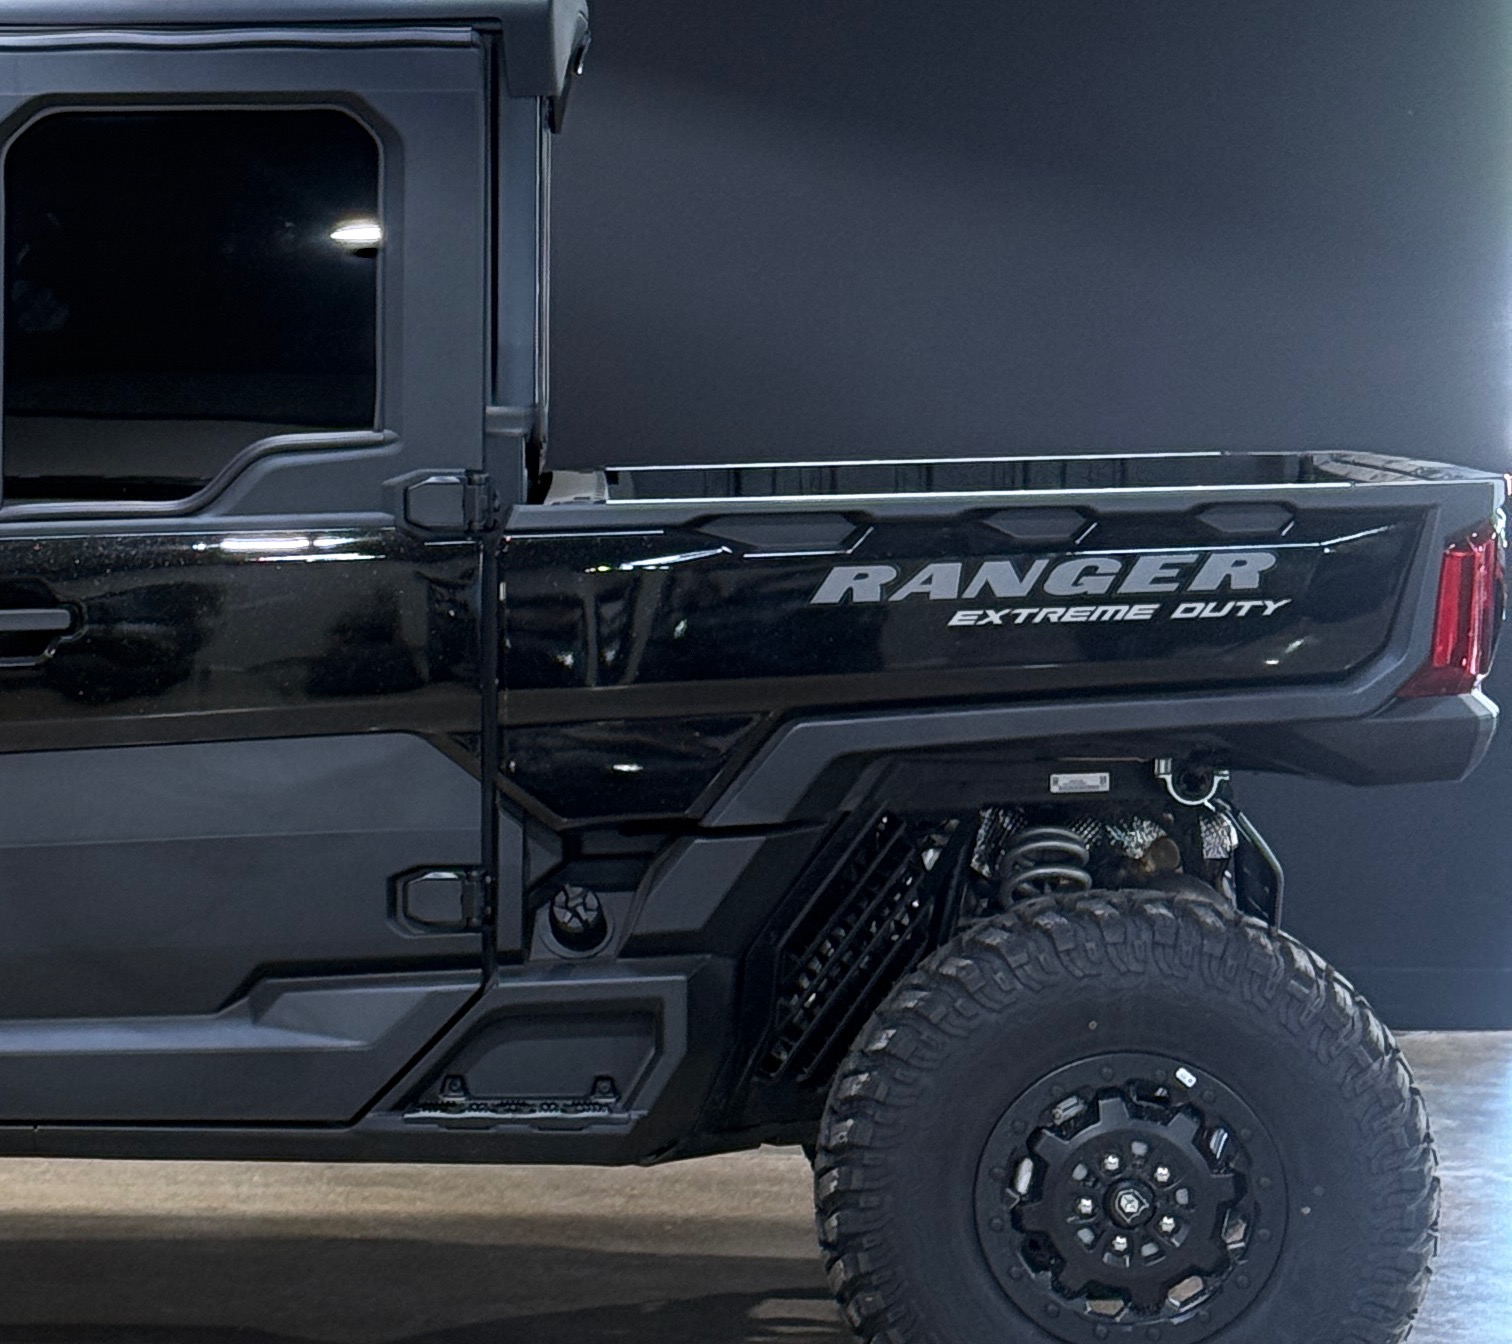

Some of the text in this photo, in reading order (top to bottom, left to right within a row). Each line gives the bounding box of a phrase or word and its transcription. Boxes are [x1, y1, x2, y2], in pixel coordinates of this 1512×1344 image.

[809, 552, 1277, 604] RANGER
[947, 599, 1292, 627] EXTREME DUTY
